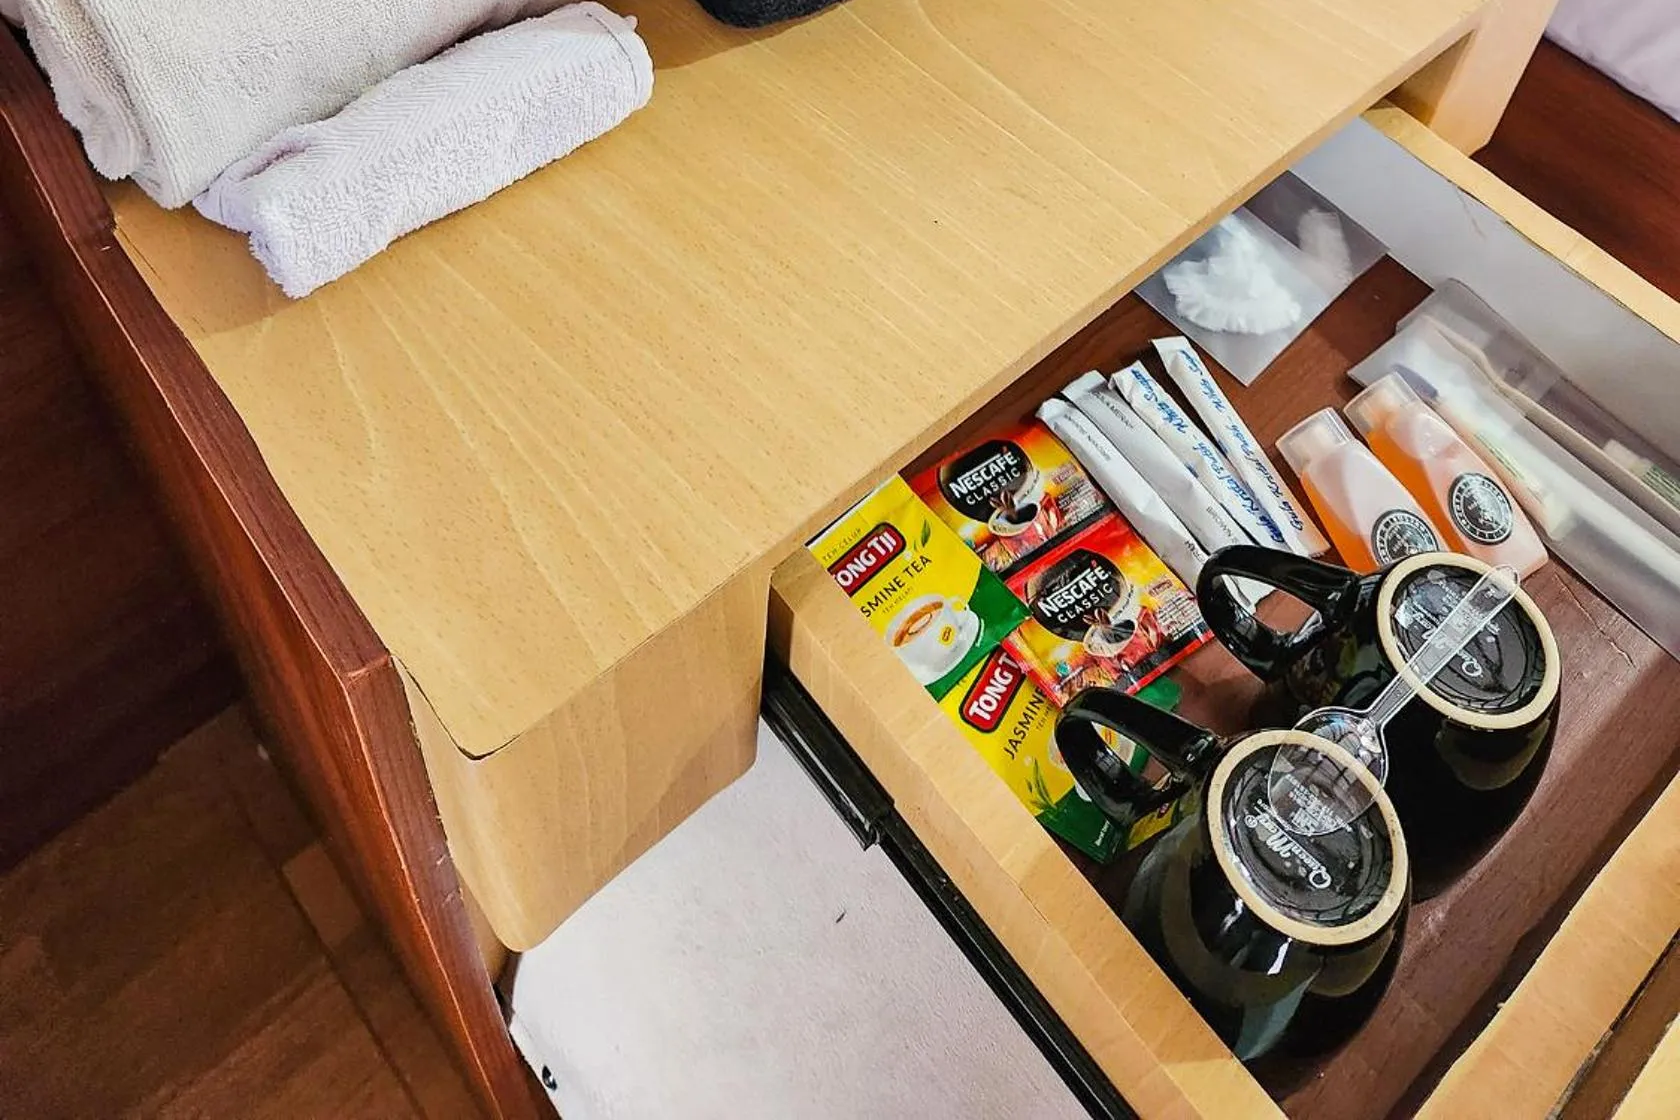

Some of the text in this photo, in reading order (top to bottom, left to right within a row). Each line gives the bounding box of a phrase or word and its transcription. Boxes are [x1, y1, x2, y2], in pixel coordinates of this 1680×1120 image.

[965, 467, 1021, 505] CLASSIC
[834, 531, 897, 587] ONG TJI
[860, 555, 932, 618] SMINE TEA
[1056, 583, 1114, 624] CLASSIC
[968, 667, 1013, 721] TONG
